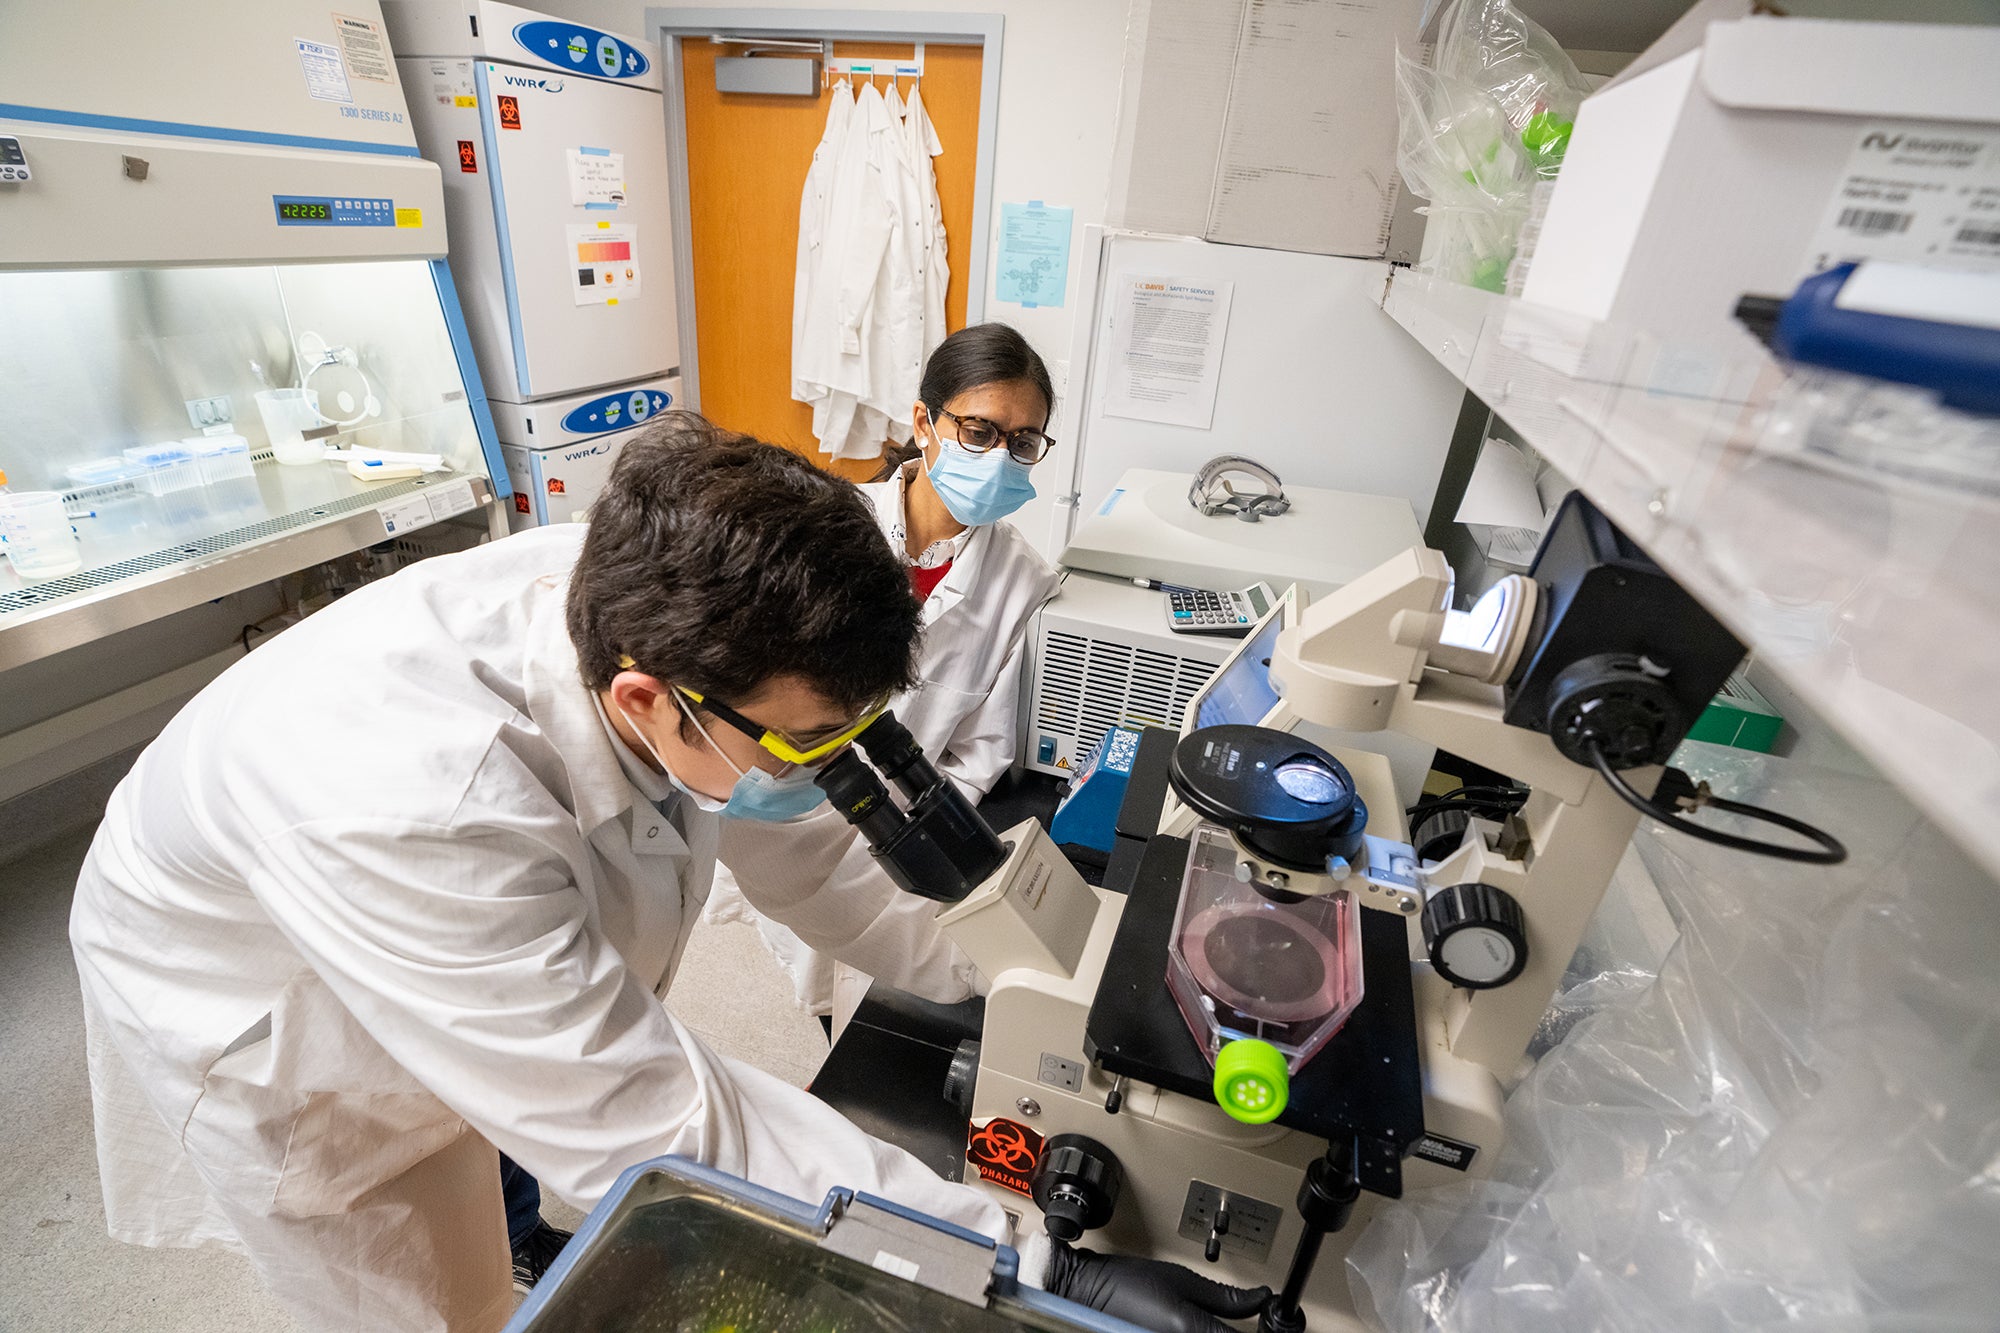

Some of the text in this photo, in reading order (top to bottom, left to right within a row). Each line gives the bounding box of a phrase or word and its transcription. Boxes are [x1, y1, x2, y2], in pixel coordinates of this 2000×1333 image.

[343, 19, 370, 30] WARNING
[504, 75, 537, 89] VWR
[340, 106, 403, 124] 1300 SERIES A2
[1144, 283, 1165, 291] DAVIS
[1169, 285, 1189, 293] SAFETY
[1190, 287, 1215, 296] SERVICES
[564, 449, 590, 461] VWR
[1226, 749, 1241, 772] Nikon
[1420, 1138, 1462, 1156] Nikon
[978, 1165, 1029, 1191] OHAZARD
